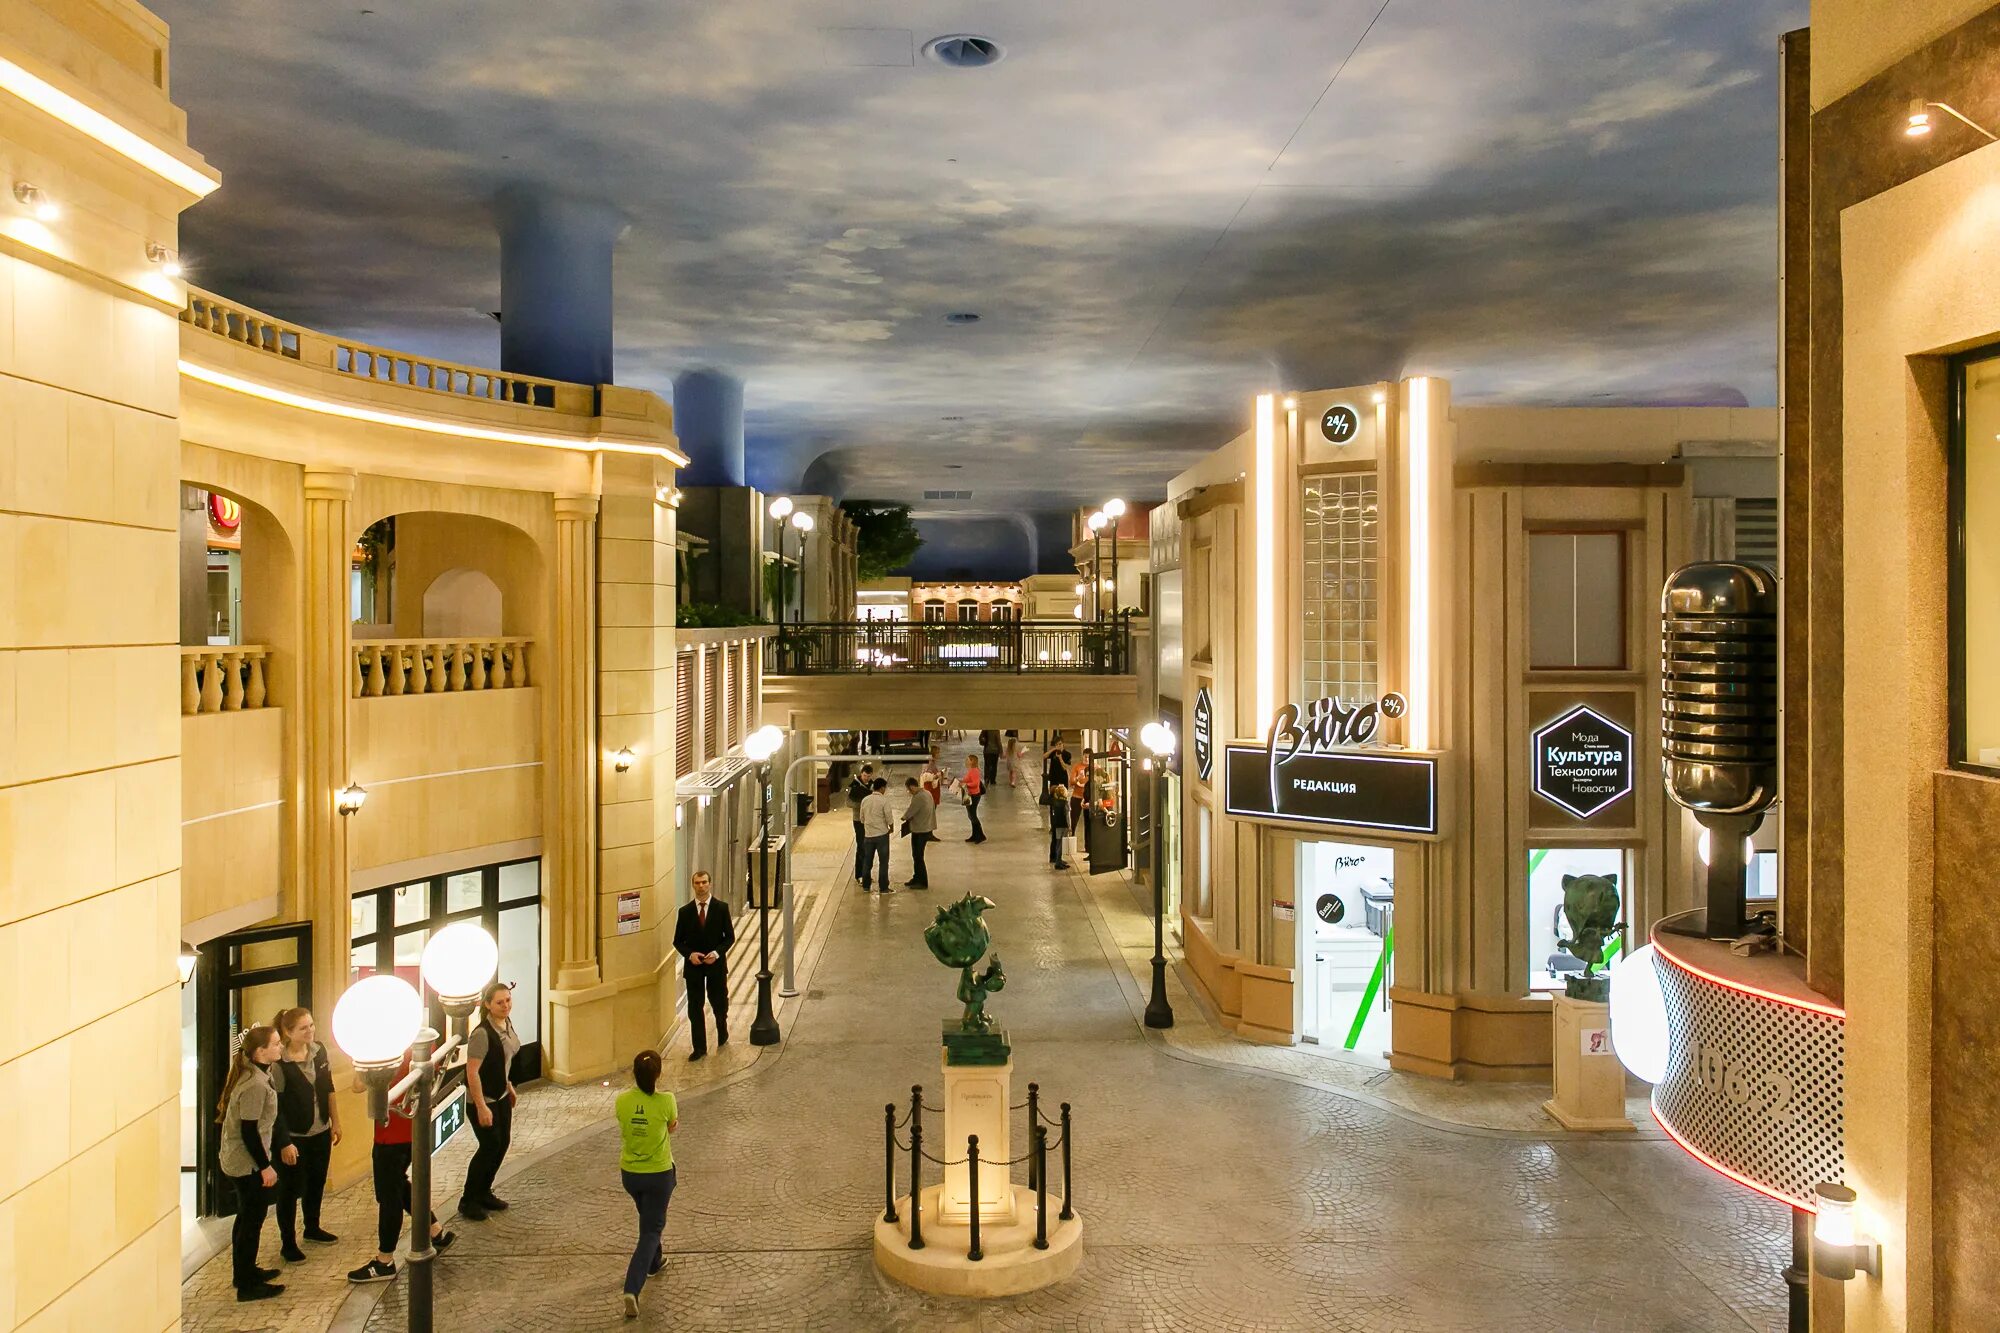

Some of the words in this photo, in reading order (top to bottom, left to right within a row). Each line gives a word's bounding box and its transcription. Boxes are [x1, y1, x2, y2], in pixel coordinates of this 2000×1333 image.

[1326, 414, 1349, 435] 24/7
[1384, 699, 1401, 714] 24/7
[1572, 733, 1599, 742] Мода
[1547, 746, 1622, 765] Культура
[1548, 765, 1618, 777] Технологии
[1293, 778, 1357, 794] РЕДАКЦИЯ
[1572, 784, 1616, 793] Новости
[1688, 1039, 1796, 1124] 106.2
